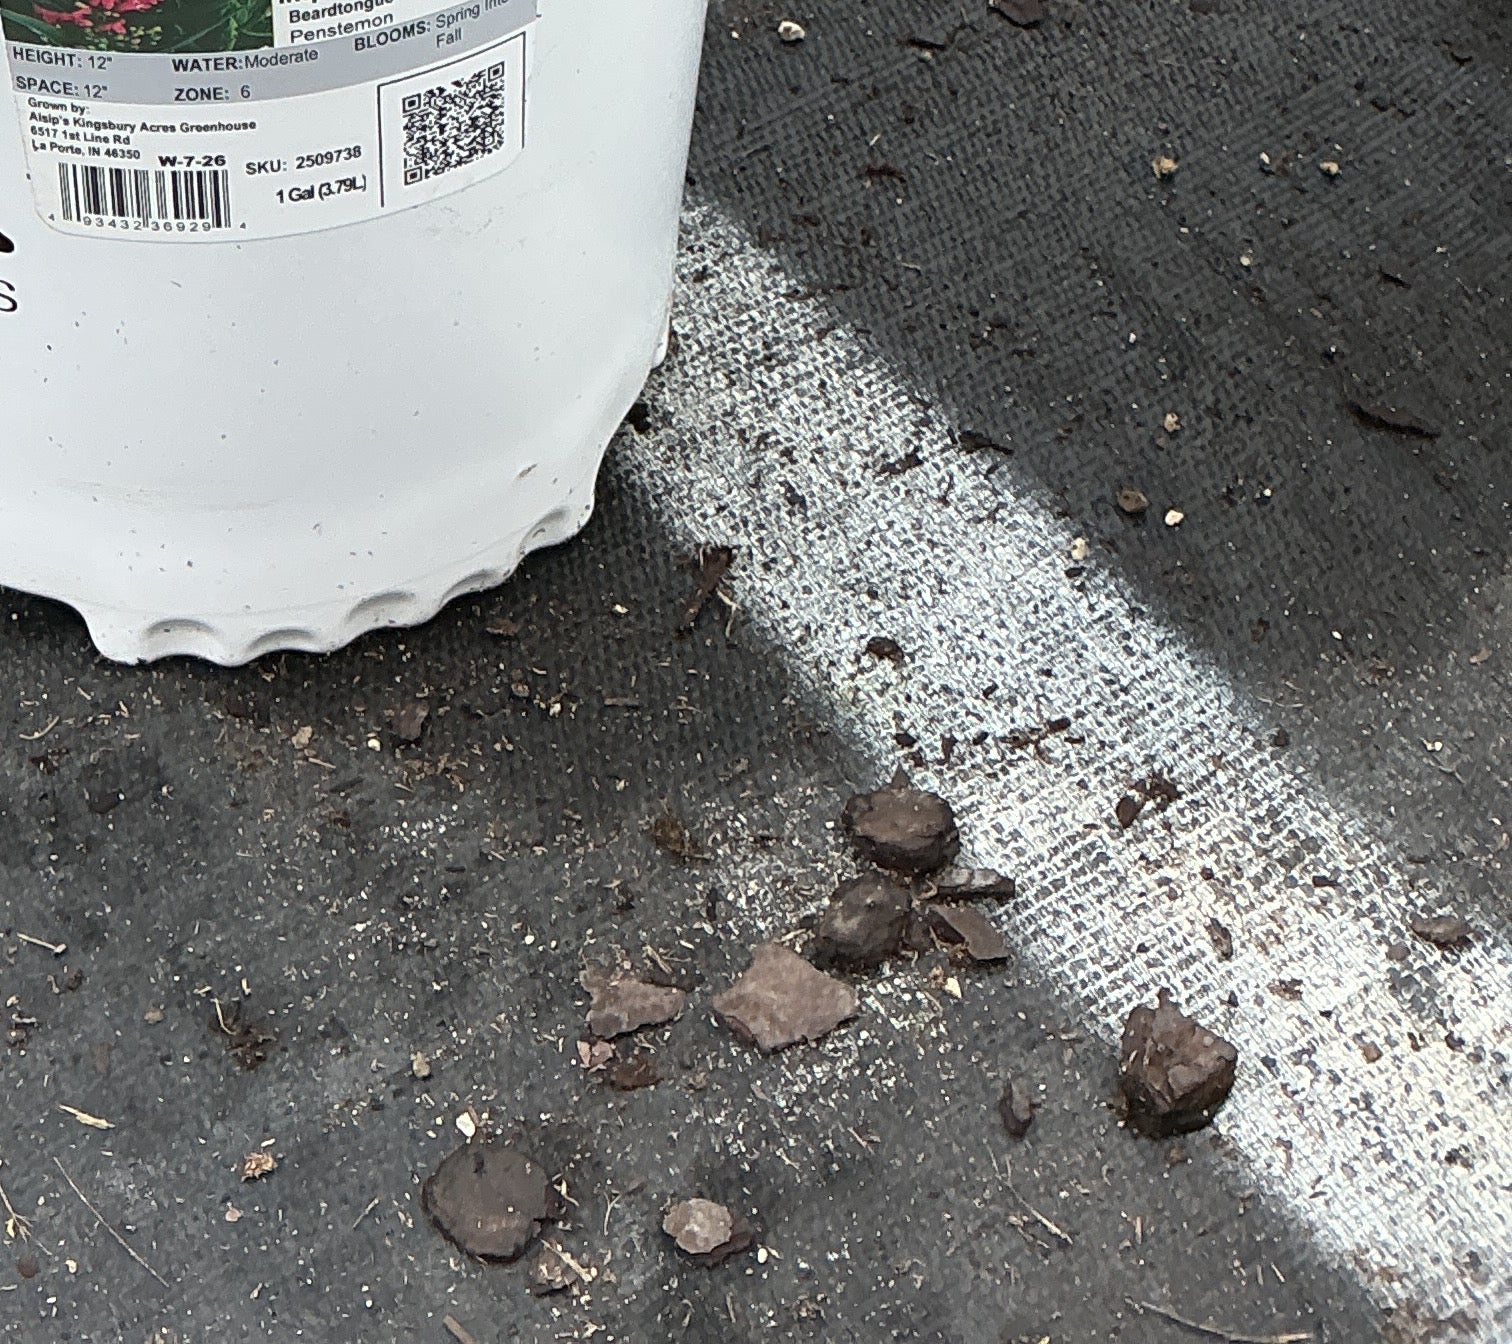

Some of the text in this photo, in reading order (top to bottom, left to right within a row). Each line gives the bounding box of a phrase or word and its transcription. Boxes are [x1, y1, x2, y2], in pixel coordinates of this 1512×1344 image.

[290, 12, 394, 43] Penstemon
[354, 21, 430, 51] BLOOMS:
[436, 3, 480, 29] Spring
[436, 27, 462, 49] Fall
[13, 46, 112, 70] HEIGHT: 12"
[172, 47, 319, 72] WATER: Moderate
[16, 76, 107, 99] SPACE: 12"
[174, 85, 250, 102] ZONE: 6
[28, 97, 90, 115] Grown by:
[29, 112, 256, 133] Alsip's Kingsbury Acres Greenhouse
[31, 127, 130, 145] 6517 1st Line Rd
[32, 139, 46, 152] La
[88, 145, 101, 157] IN
[104, 148, 141, 159] 46350
[158, 155, 226, 167] W-7-26
[245, 146, 361, 175] SKU: 2509738
[276, 175, 366, 203] 1 Gal (3.79L)
[83, 216, 142, 230] 93432
[151, 222, 211, 231] 36929
